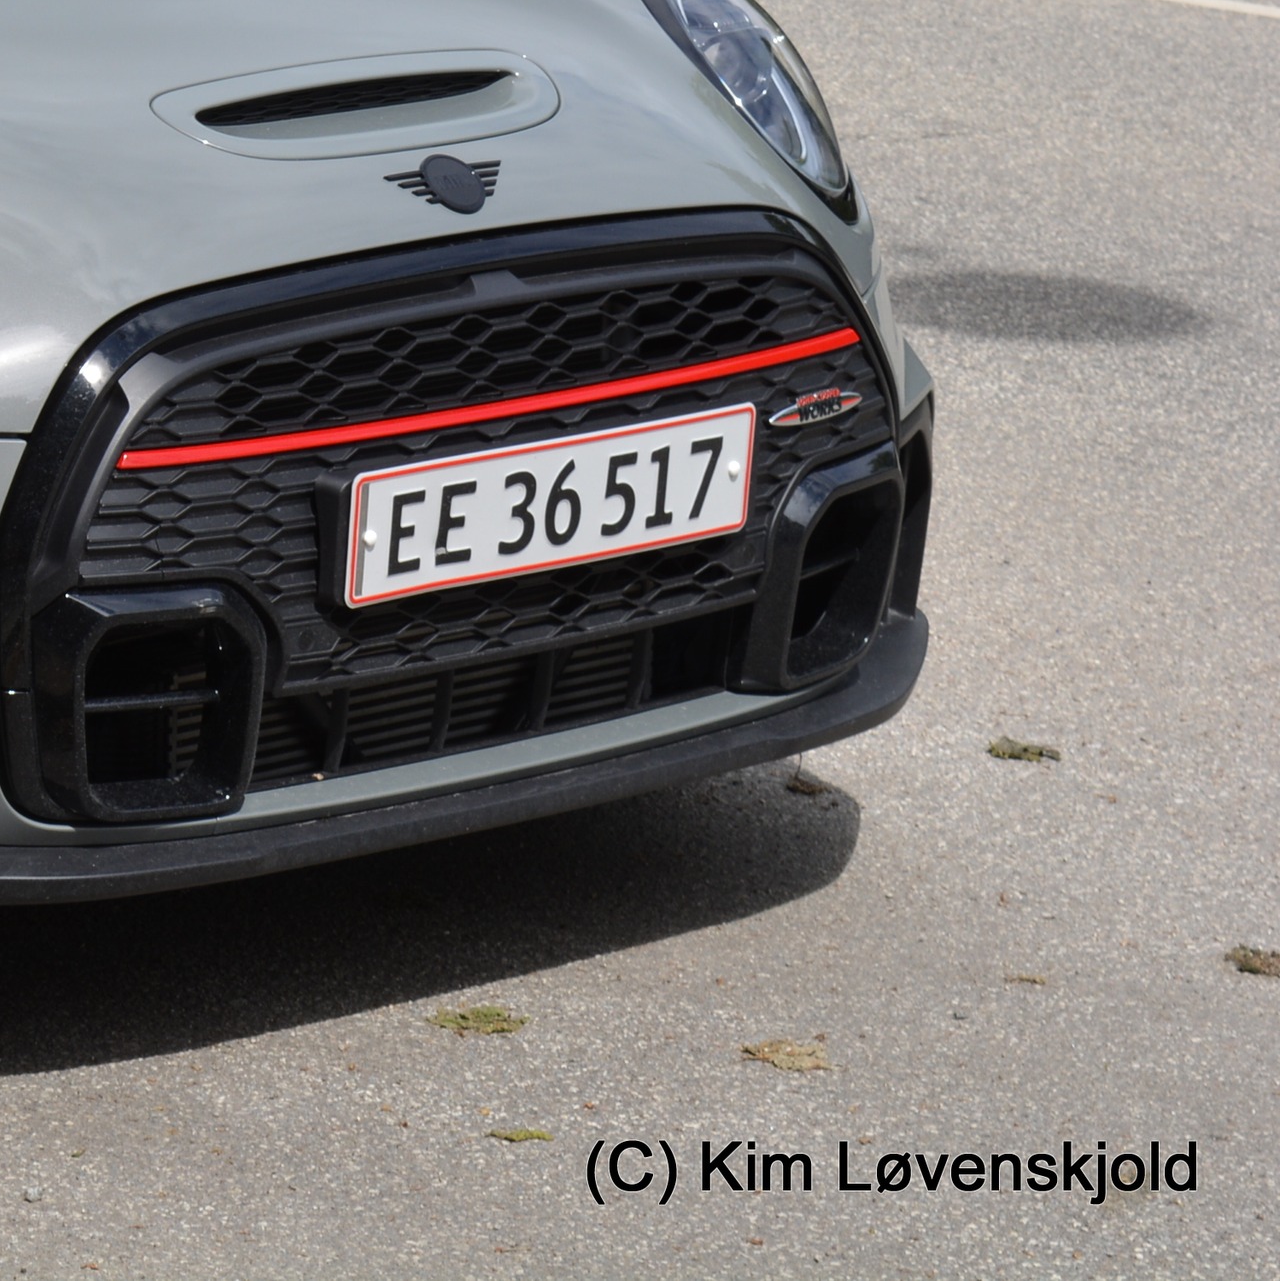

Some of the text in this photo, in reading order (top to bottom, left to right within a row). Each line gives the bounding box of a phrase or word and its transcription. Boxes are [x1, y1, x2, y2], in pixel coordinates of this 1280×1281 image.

[387, 436, 724, 577] EE 36 517
